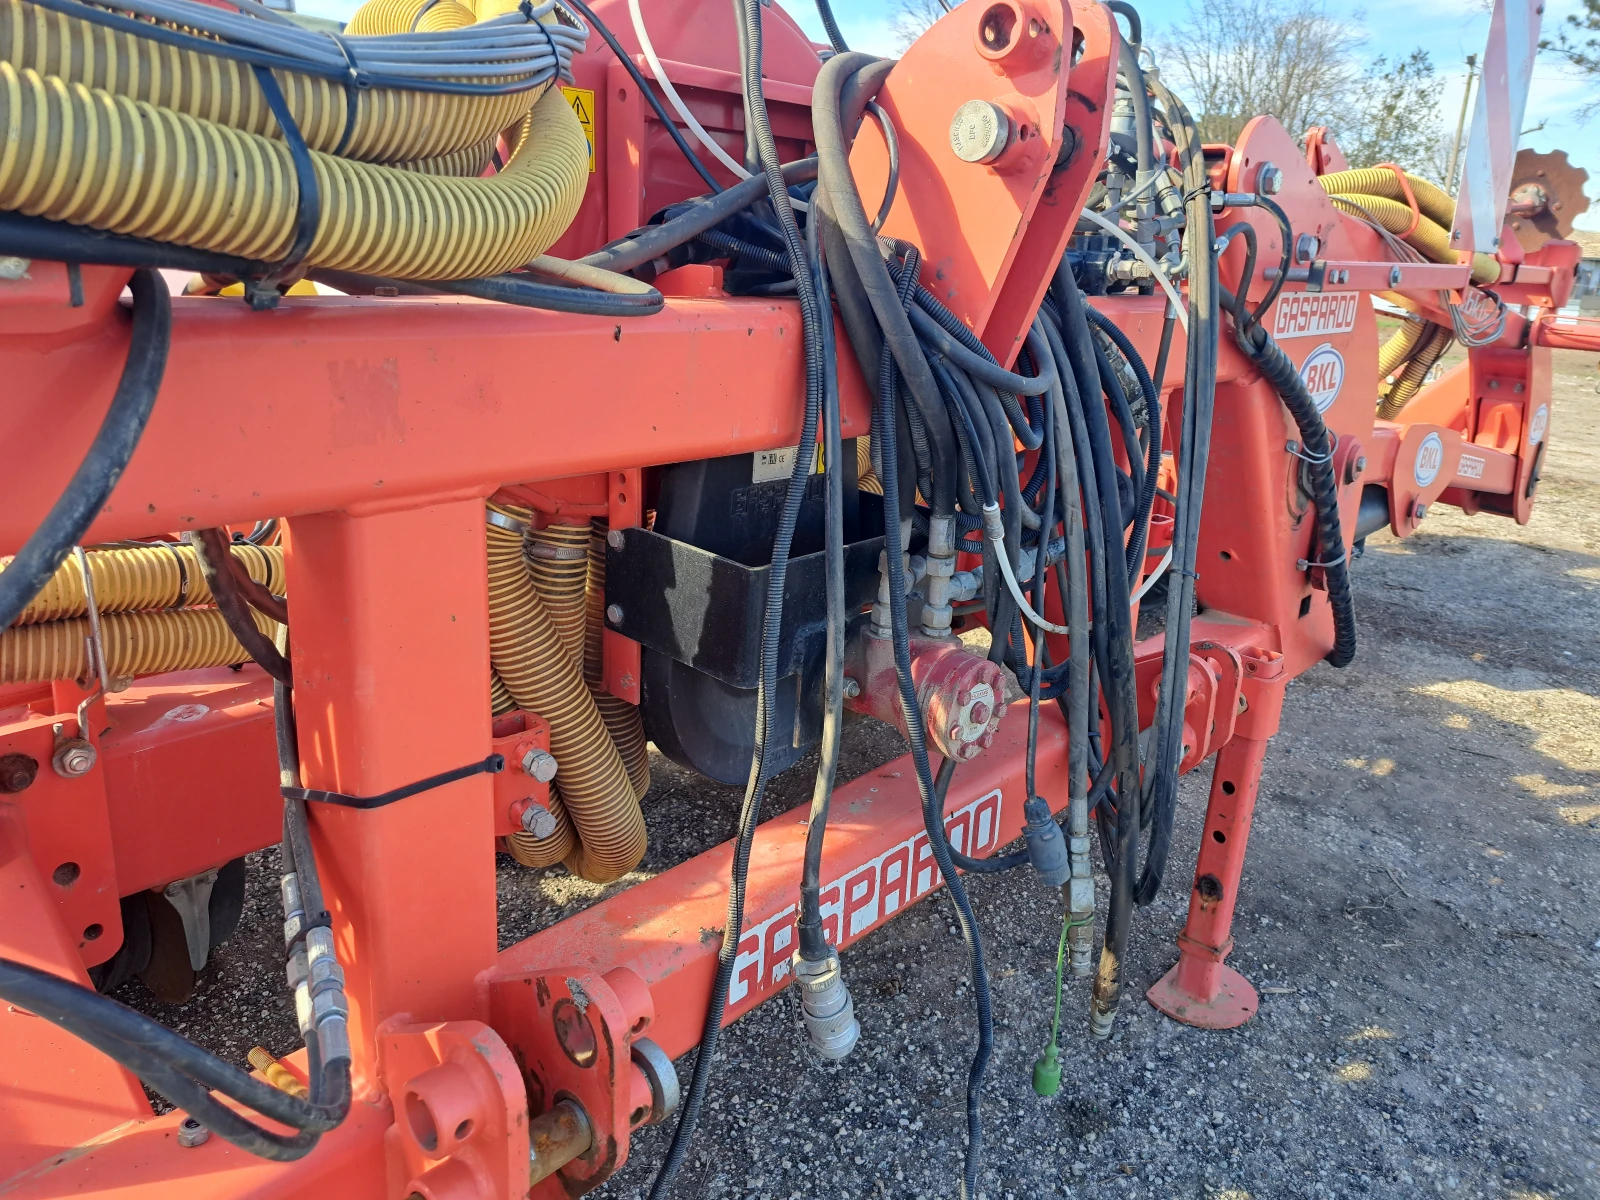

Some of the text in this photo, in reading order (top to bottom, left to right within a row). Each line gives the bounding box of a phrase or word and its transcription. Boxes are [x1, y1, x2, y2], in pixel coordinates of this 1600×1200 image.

[1276, 294, 1357, 334] GASPARDO
[1306, 361, 1337, 394] BKL
[1420, 446, 1439, 469] BKL
